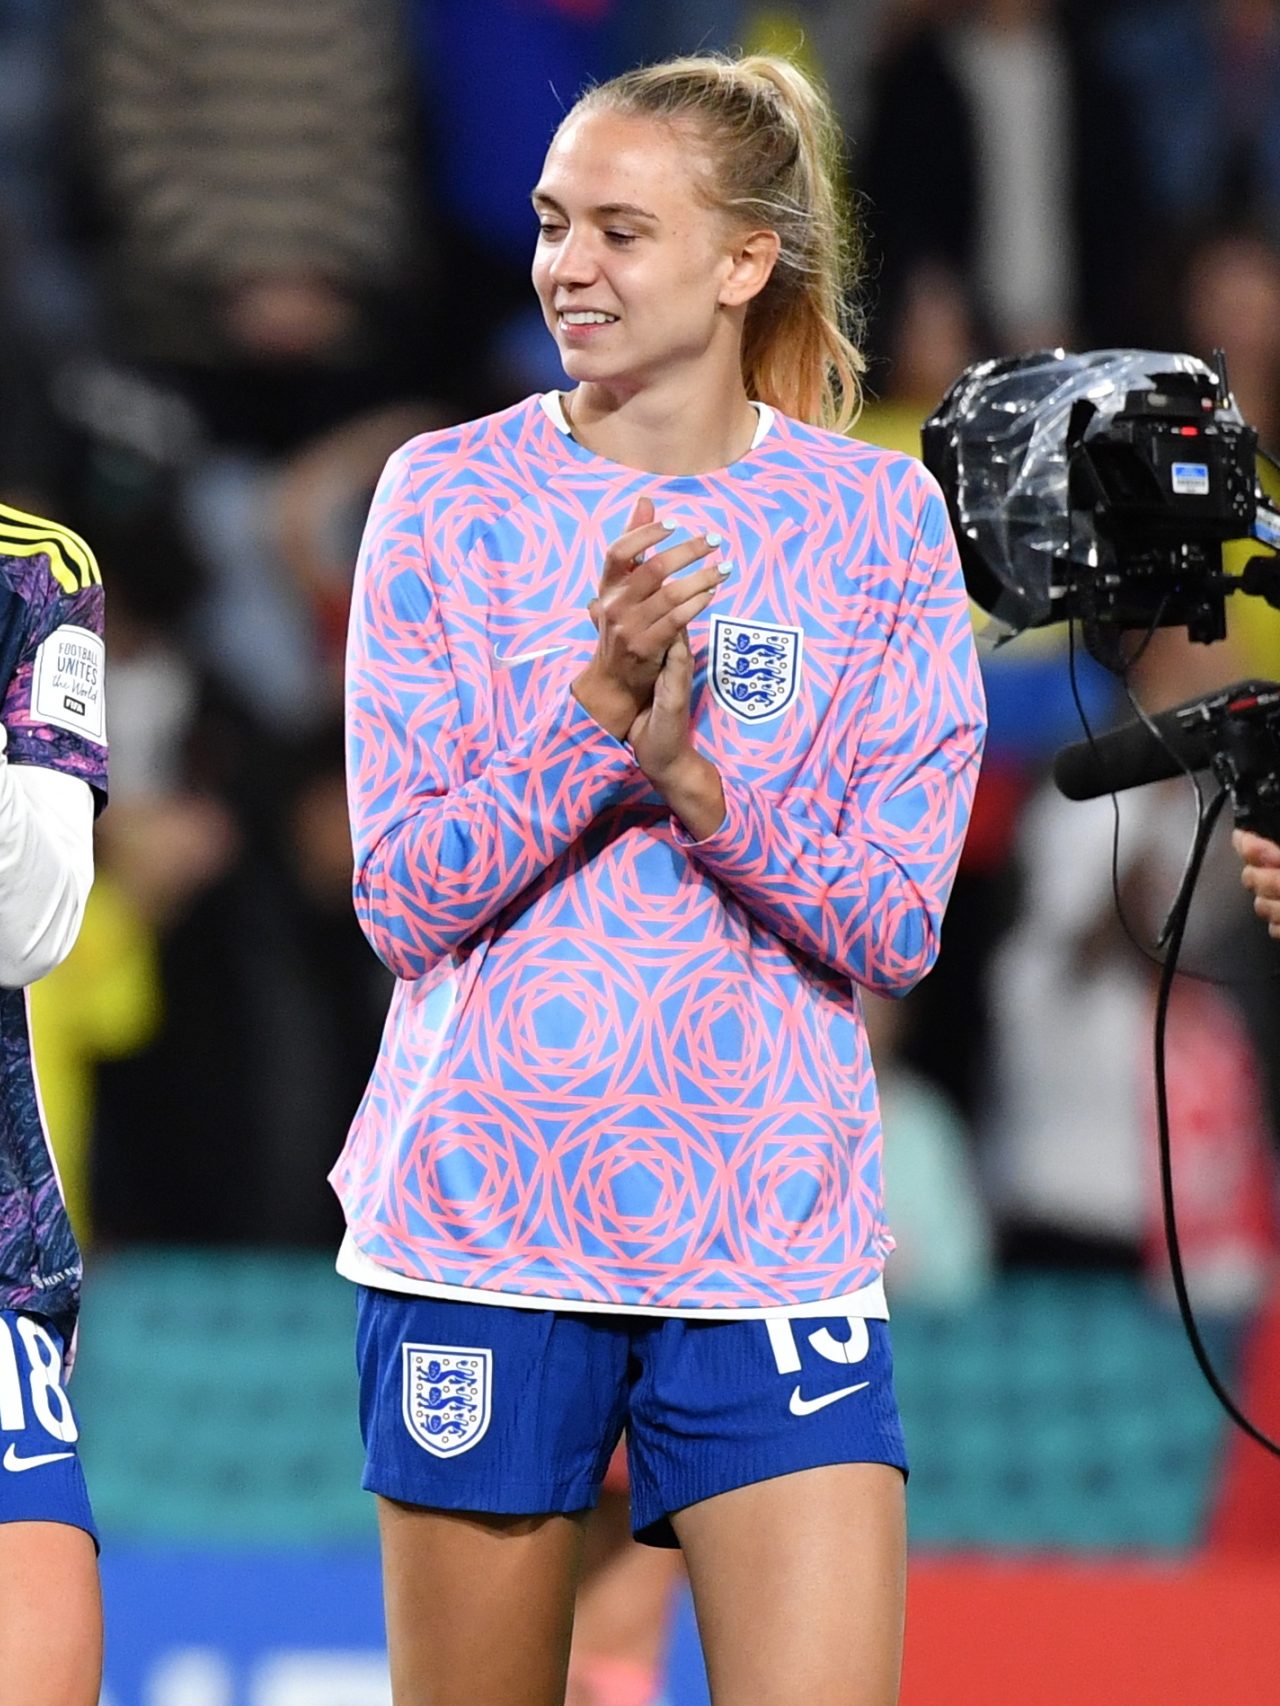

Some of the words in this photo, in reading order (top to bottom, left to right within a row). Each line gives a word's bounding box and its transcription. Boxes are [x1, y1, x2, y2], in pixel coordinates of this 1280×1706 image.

[59, 643, 97, 665] FOOTBALL
[57, 656, 98, 686] UNITES
[53, 674, 69, 689] the
[71, 679, 98, 705] World
